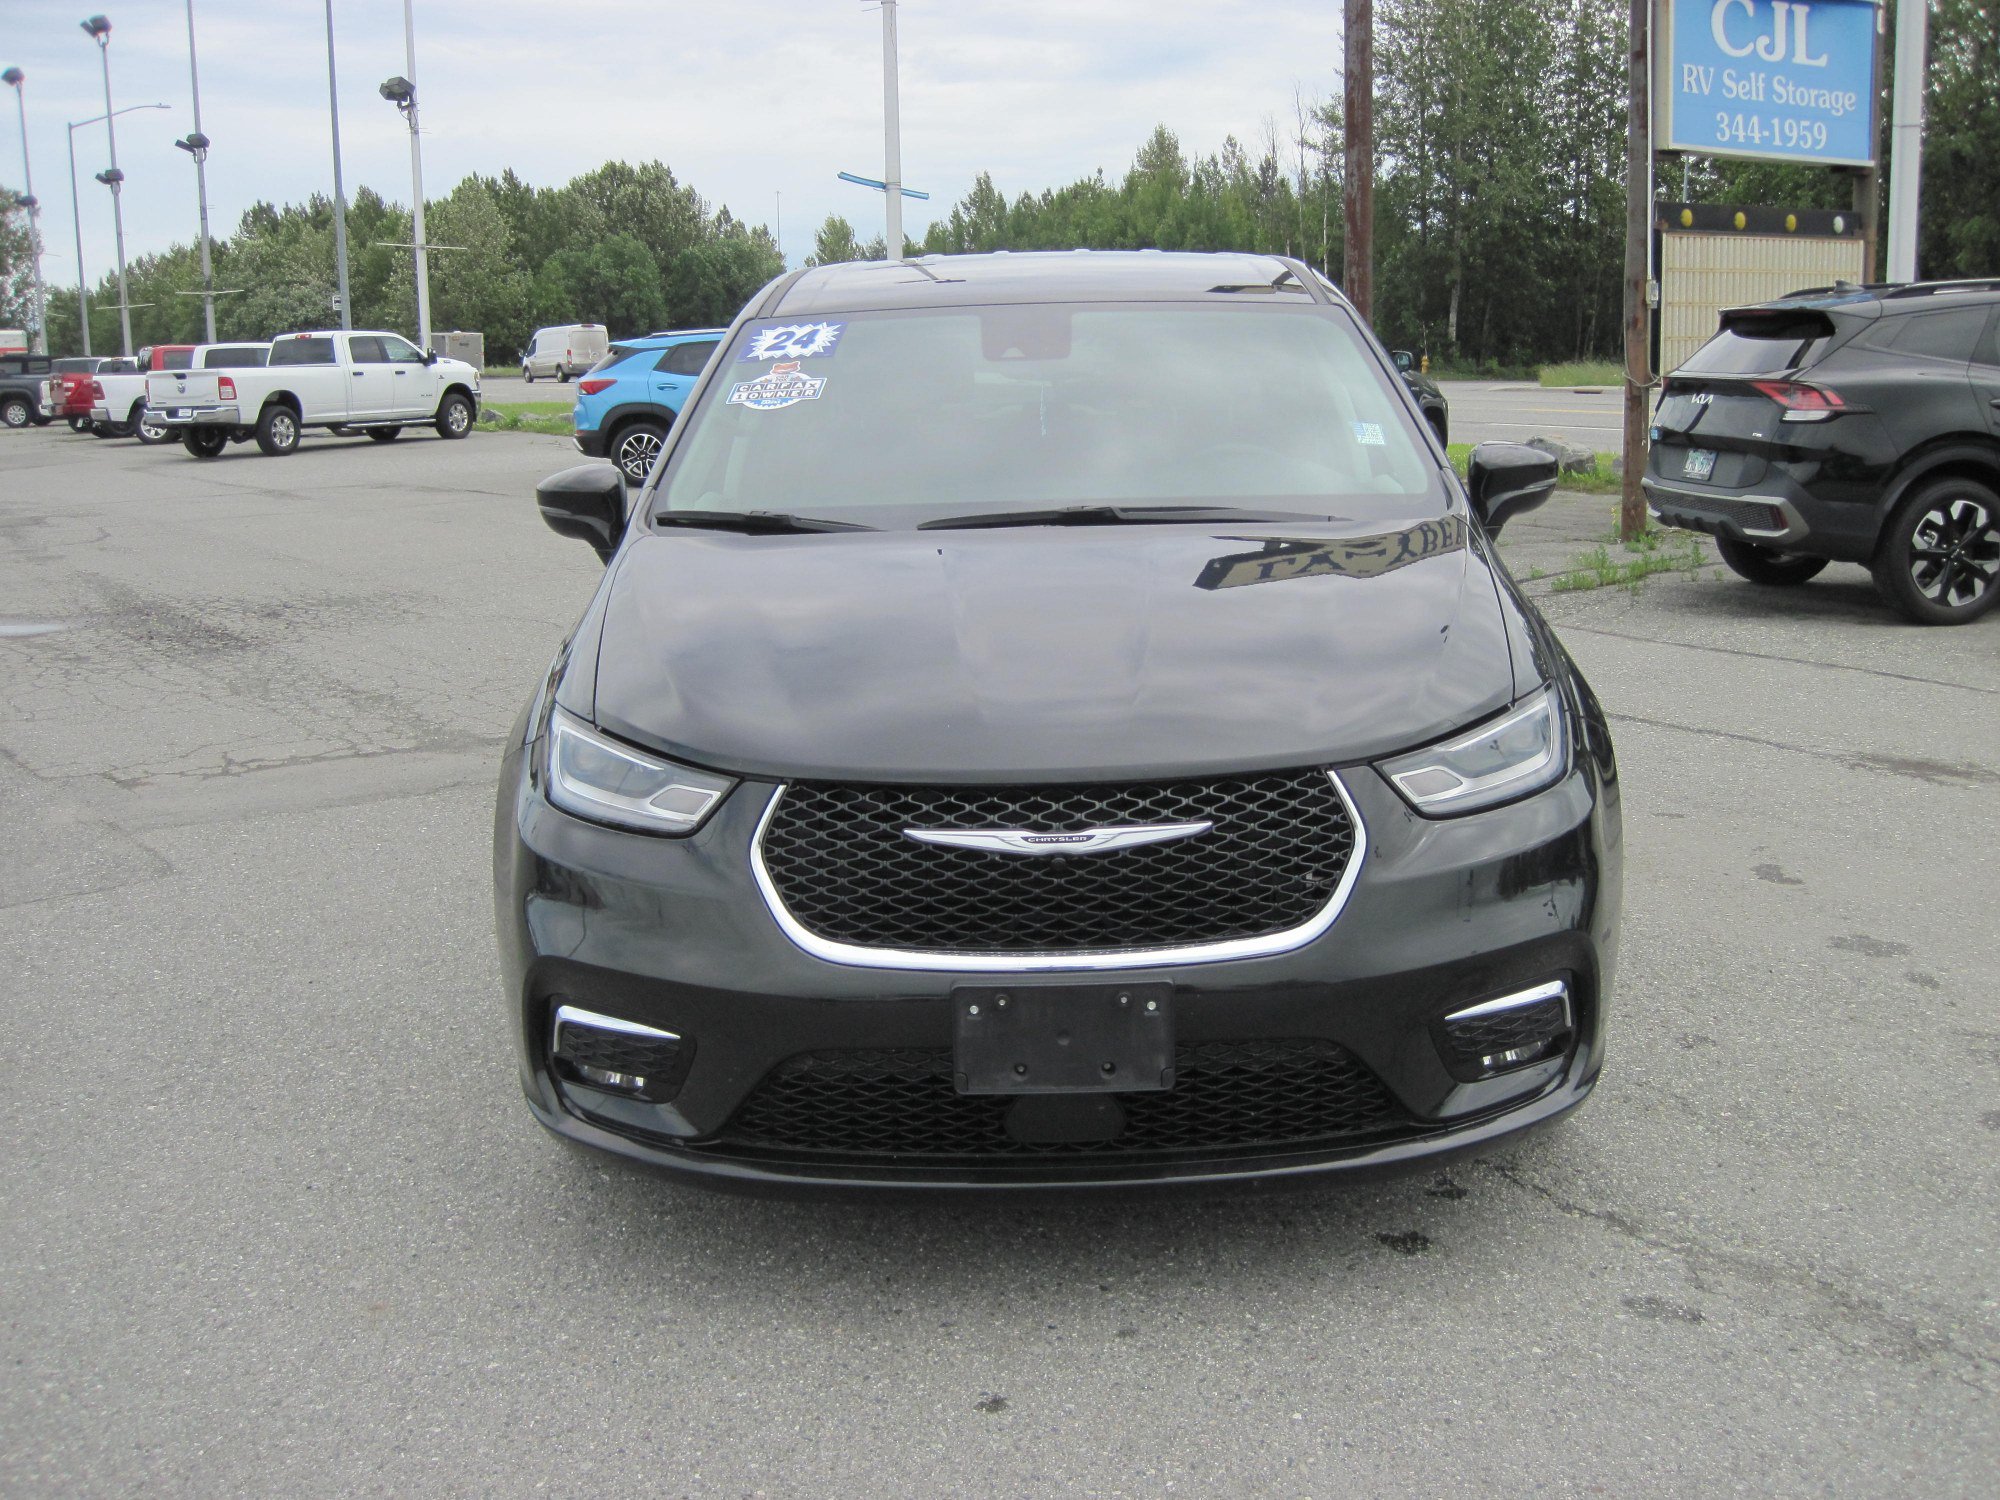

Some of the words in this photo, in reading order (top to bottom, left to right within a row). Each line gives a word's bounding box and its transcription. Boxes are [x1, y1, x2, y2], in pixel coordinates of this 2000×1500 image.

[1711, 0, 1828, 67] CJL
[1682, 64, 1714, 96] RV
[1722, 69, 1765, 102] Self
[1772, 76, 1856, 116] Storage
[1716, 112, 1827, 150] 344-1959
[764, 329, 821, 352] 24
[738, 382, 818, 392] CARFAX
[1691, 393, 1714, 405] KIA
